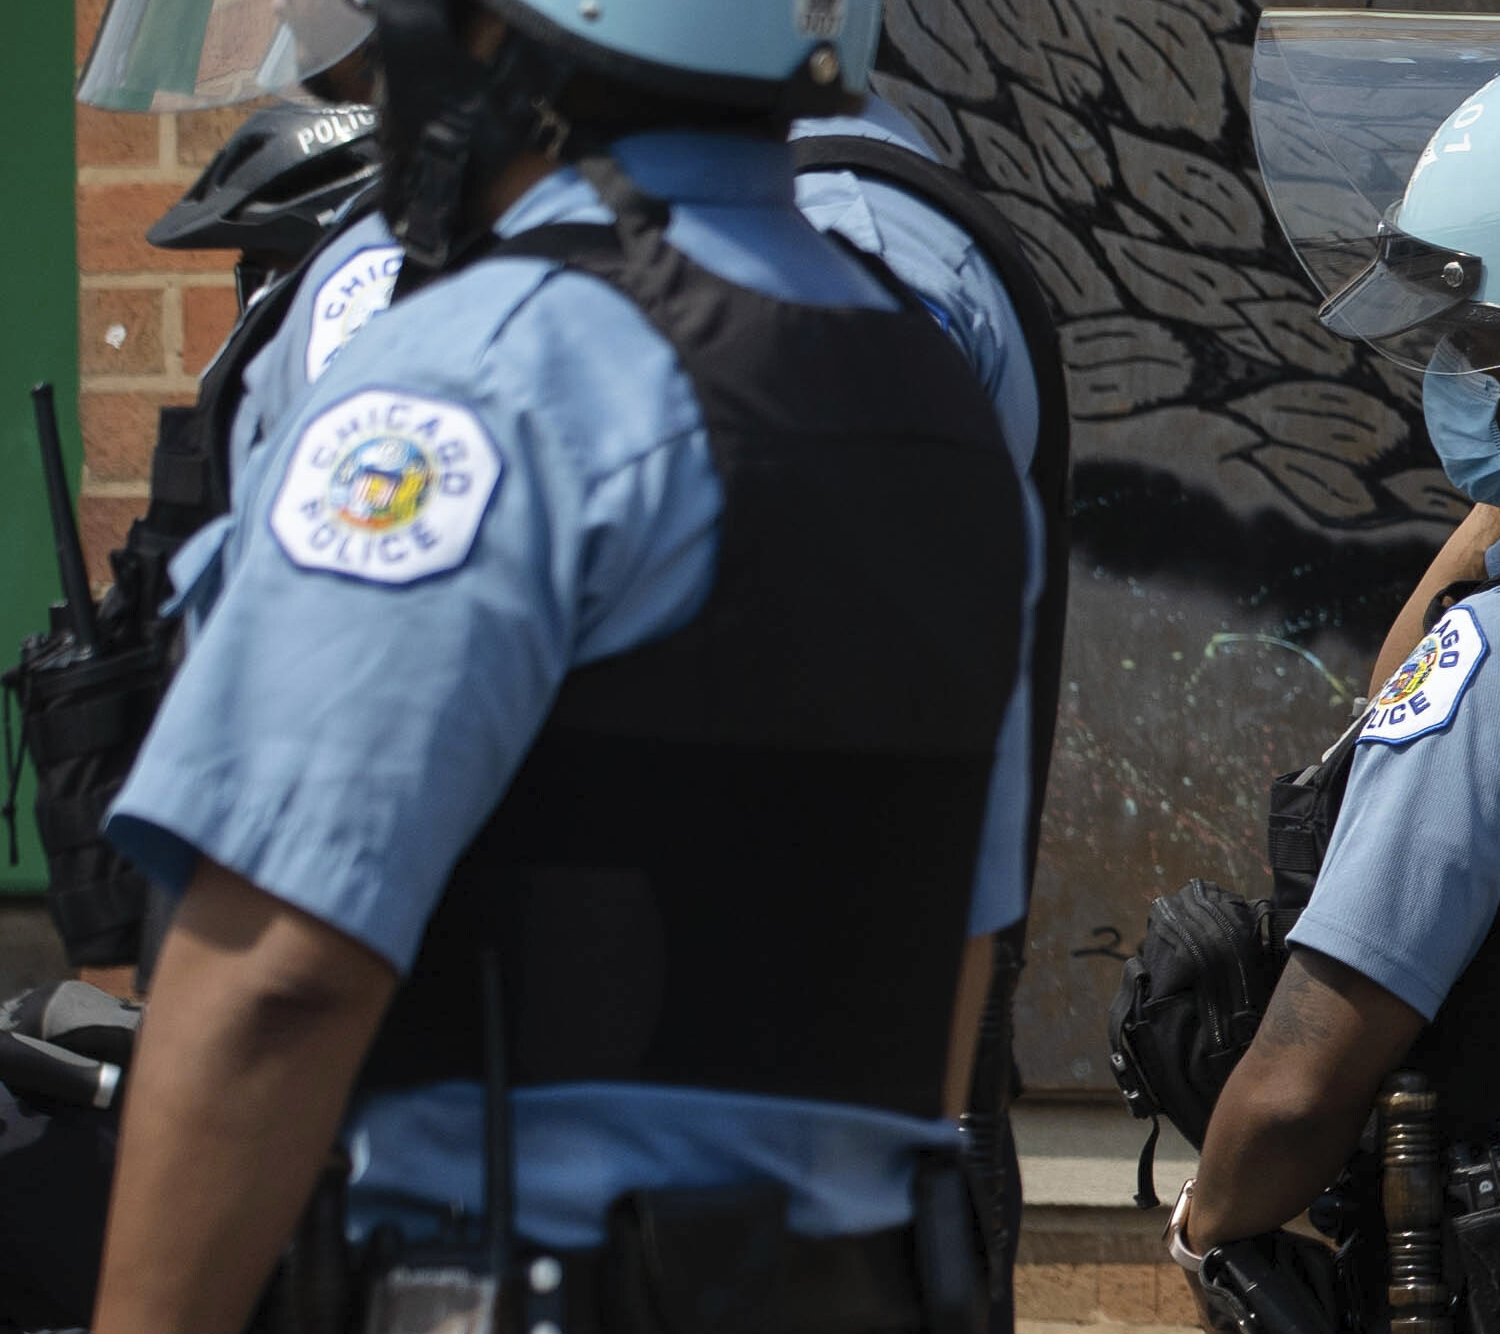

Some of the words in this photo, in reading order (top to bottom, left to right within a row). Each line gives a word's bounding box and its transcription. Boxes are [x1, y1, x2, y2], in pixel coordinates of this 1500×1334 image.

[297, 109, 377, 155] POLIC
[311, 403, 472, 497] CHICAGO
[300, 498, 440, 563] POLICE
